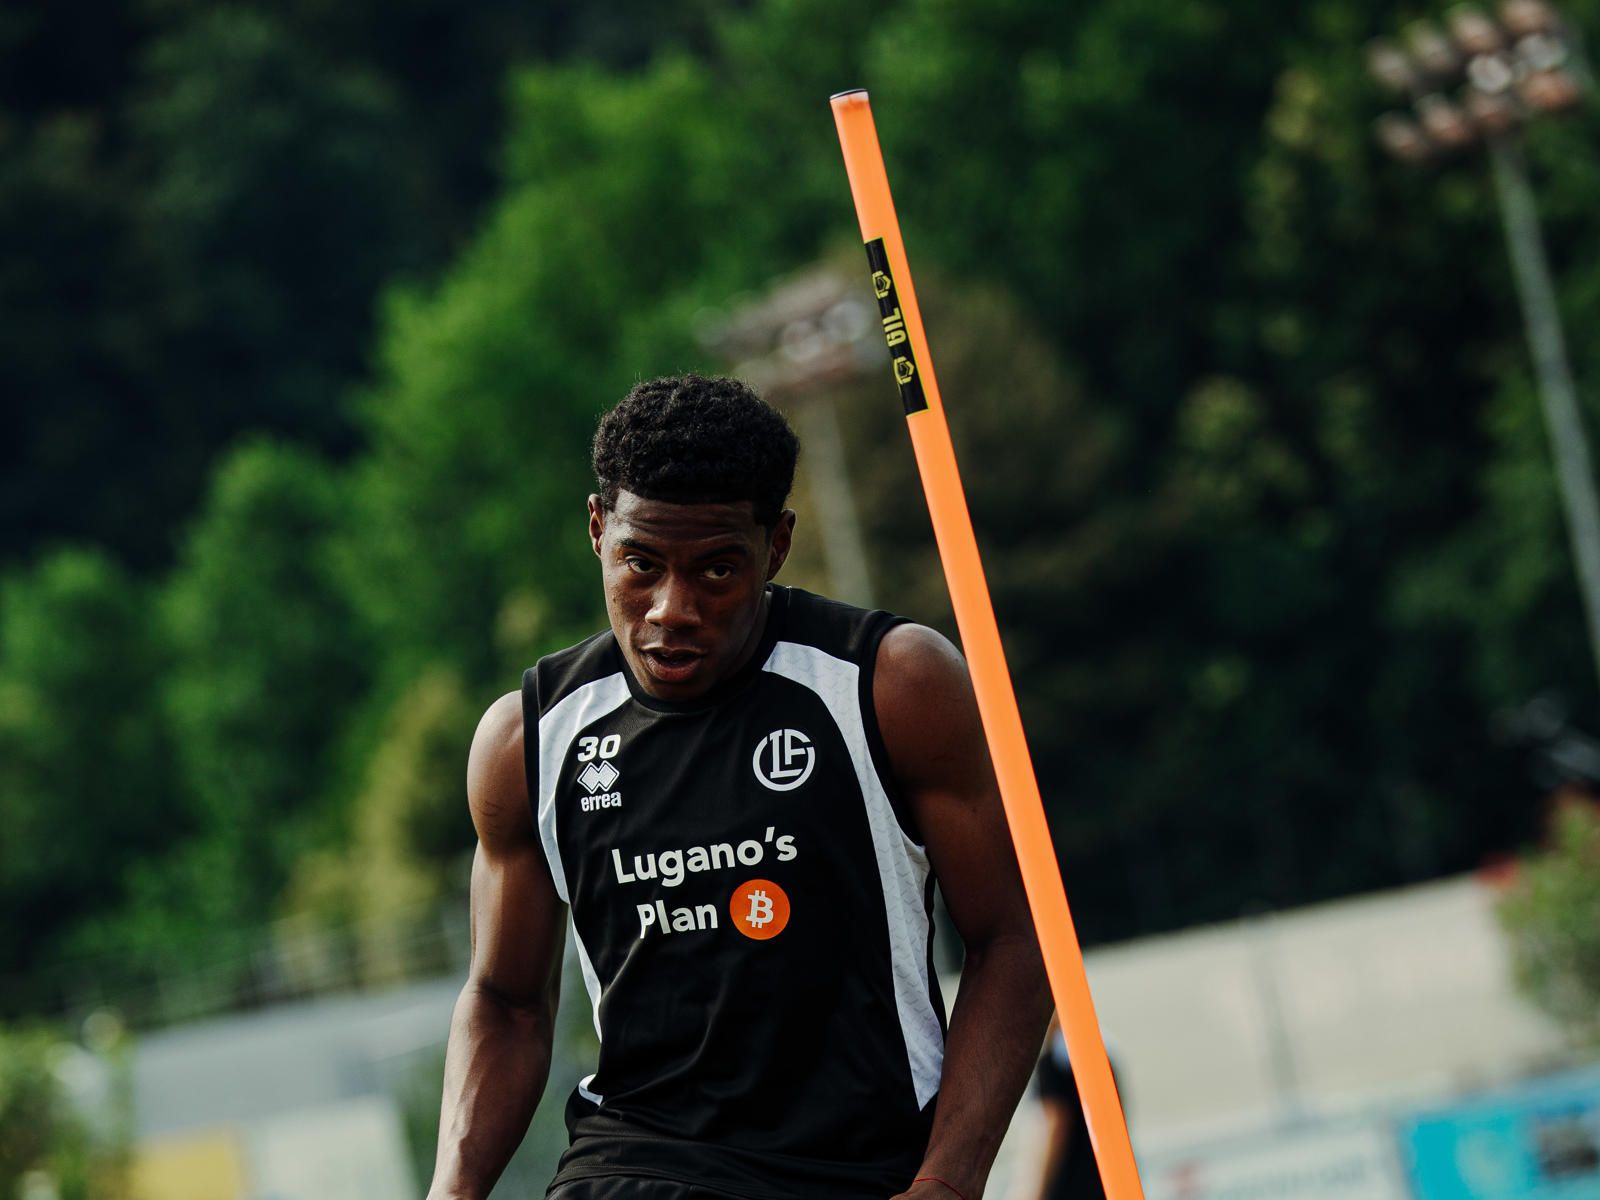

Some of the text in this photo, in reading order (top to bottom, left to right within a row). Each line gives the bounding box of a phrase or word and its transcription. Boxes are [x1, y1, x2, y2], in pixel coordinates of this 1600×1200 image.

[882, 307, 907, 347] GIL
[577, 734, 621, 762] 30
[611, 826, 798, 888] Lugano's
[636, 899, 719, 939] Plan
